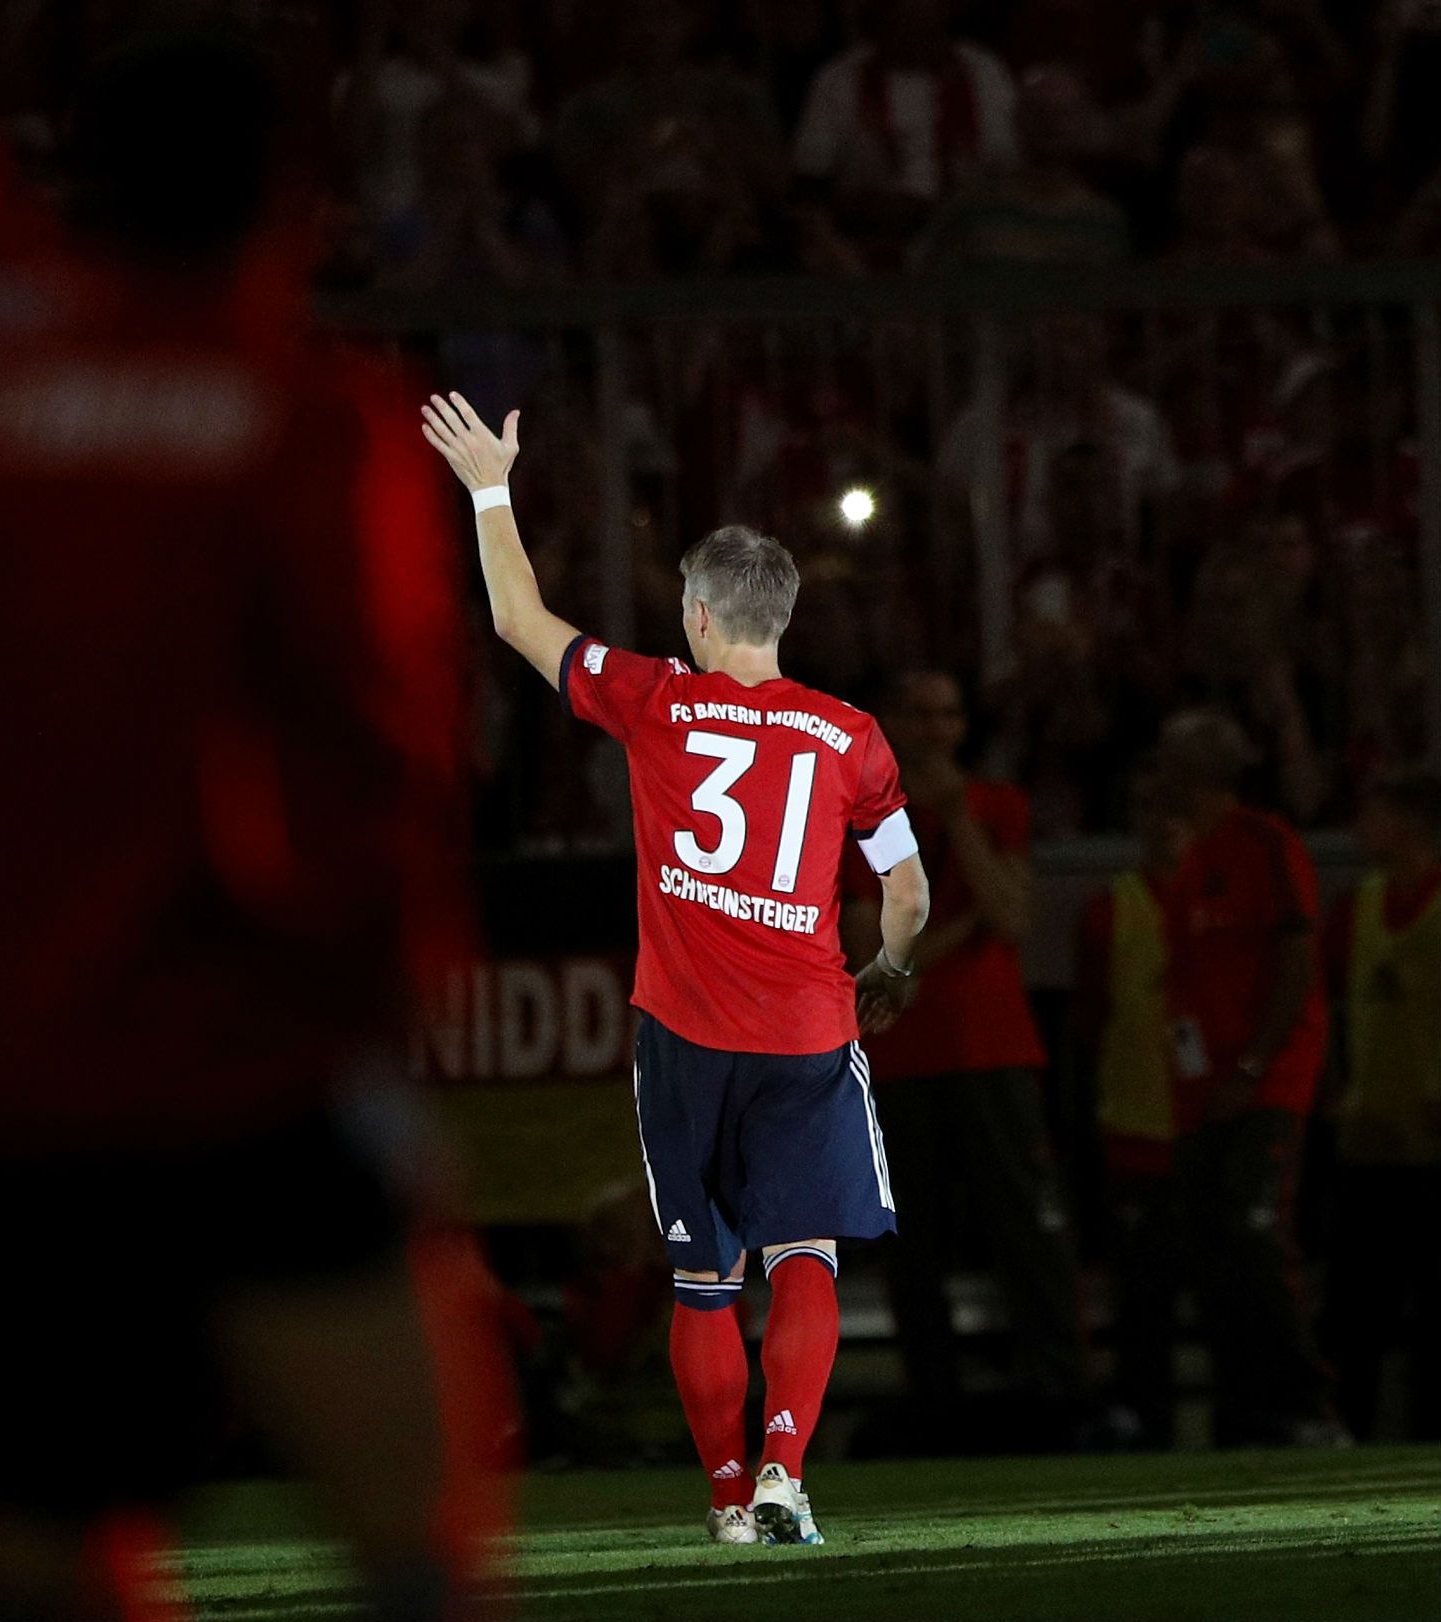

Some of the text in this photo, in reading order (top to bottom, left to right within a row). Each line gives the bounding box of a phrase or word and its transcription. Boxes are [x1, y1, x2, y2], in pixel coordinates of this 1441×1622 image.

[670, 702, 853, 755] FC BAYERN MÜNCHEN
[672, 730, 818, 895] 31
